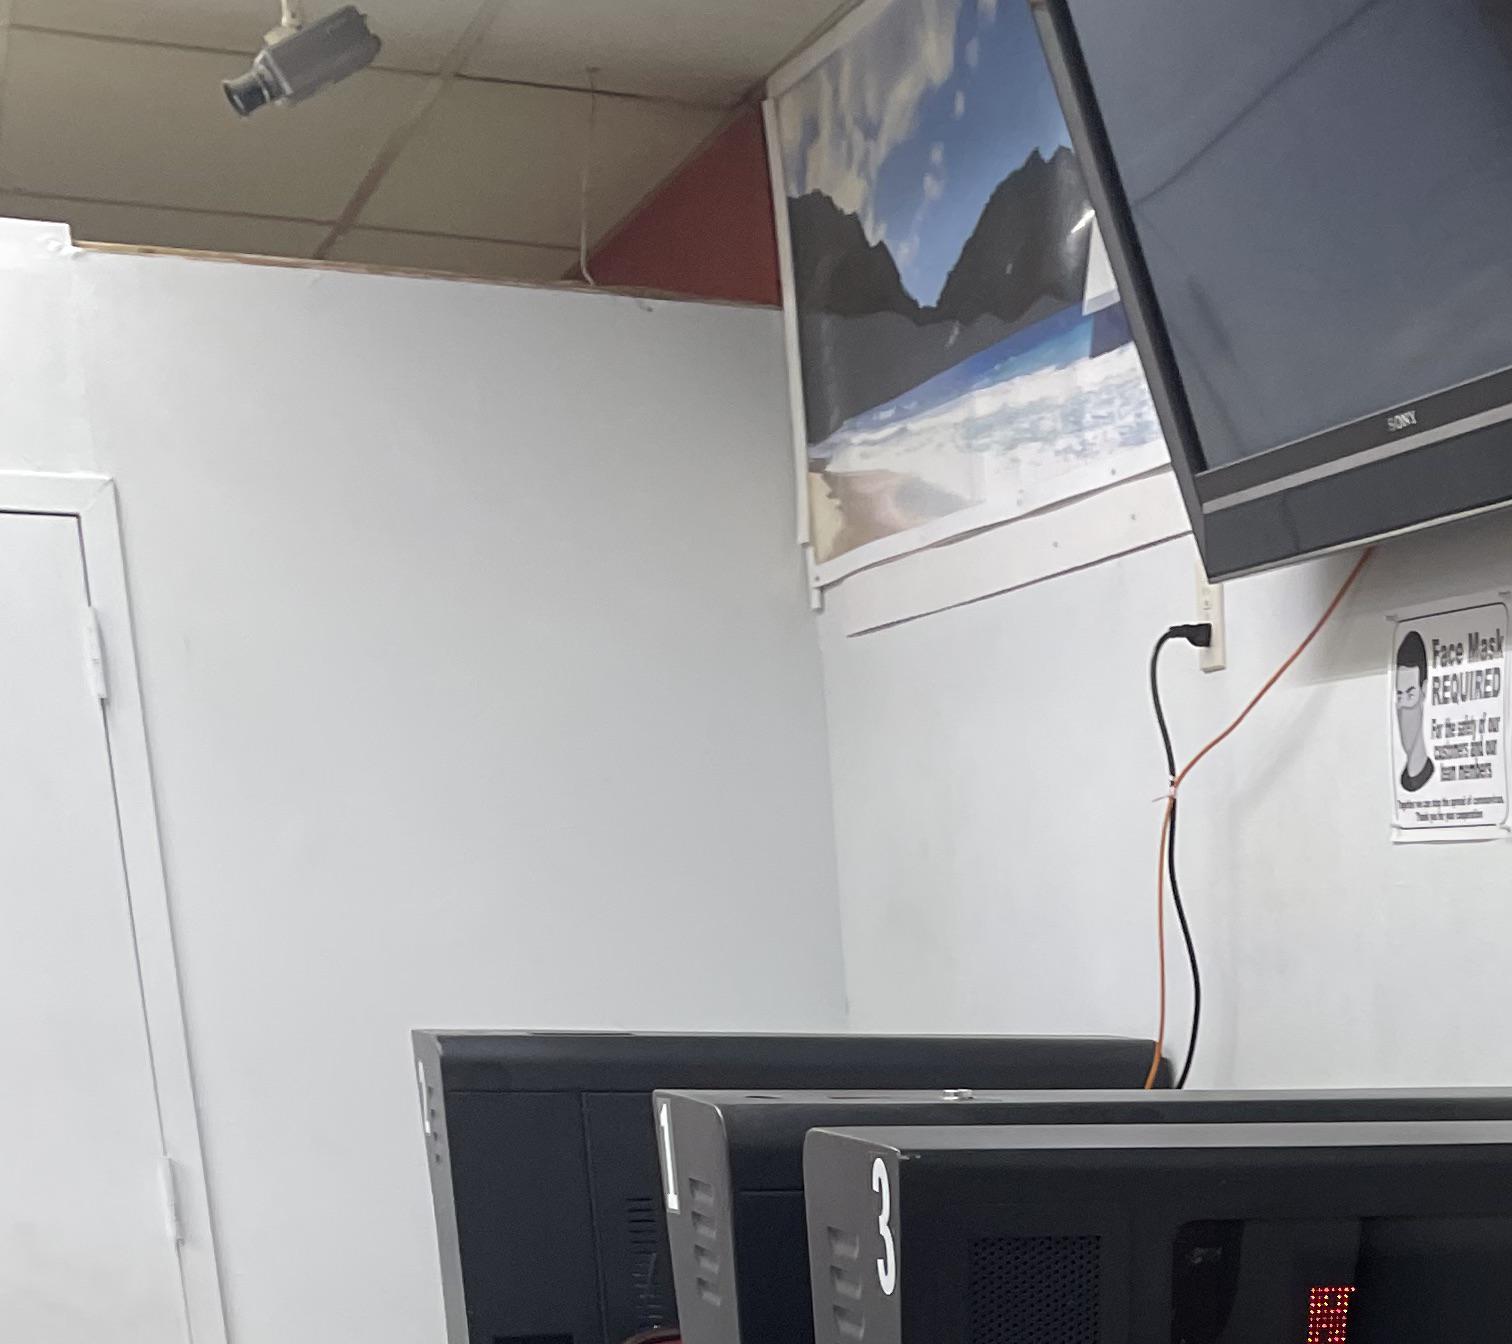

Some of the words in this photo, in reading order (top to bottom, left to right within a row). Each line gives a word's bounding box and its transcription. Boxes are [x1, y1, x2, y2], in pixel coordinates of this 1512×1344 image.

[1431, 638, 1464, 669] Face
[1467, 628, 1504, 663] Mask
[1431, 667, 1501, 706] REQUIRED
[660, 1103, 680, 1210] 1
[872, 1157, 896, 1296] 3
